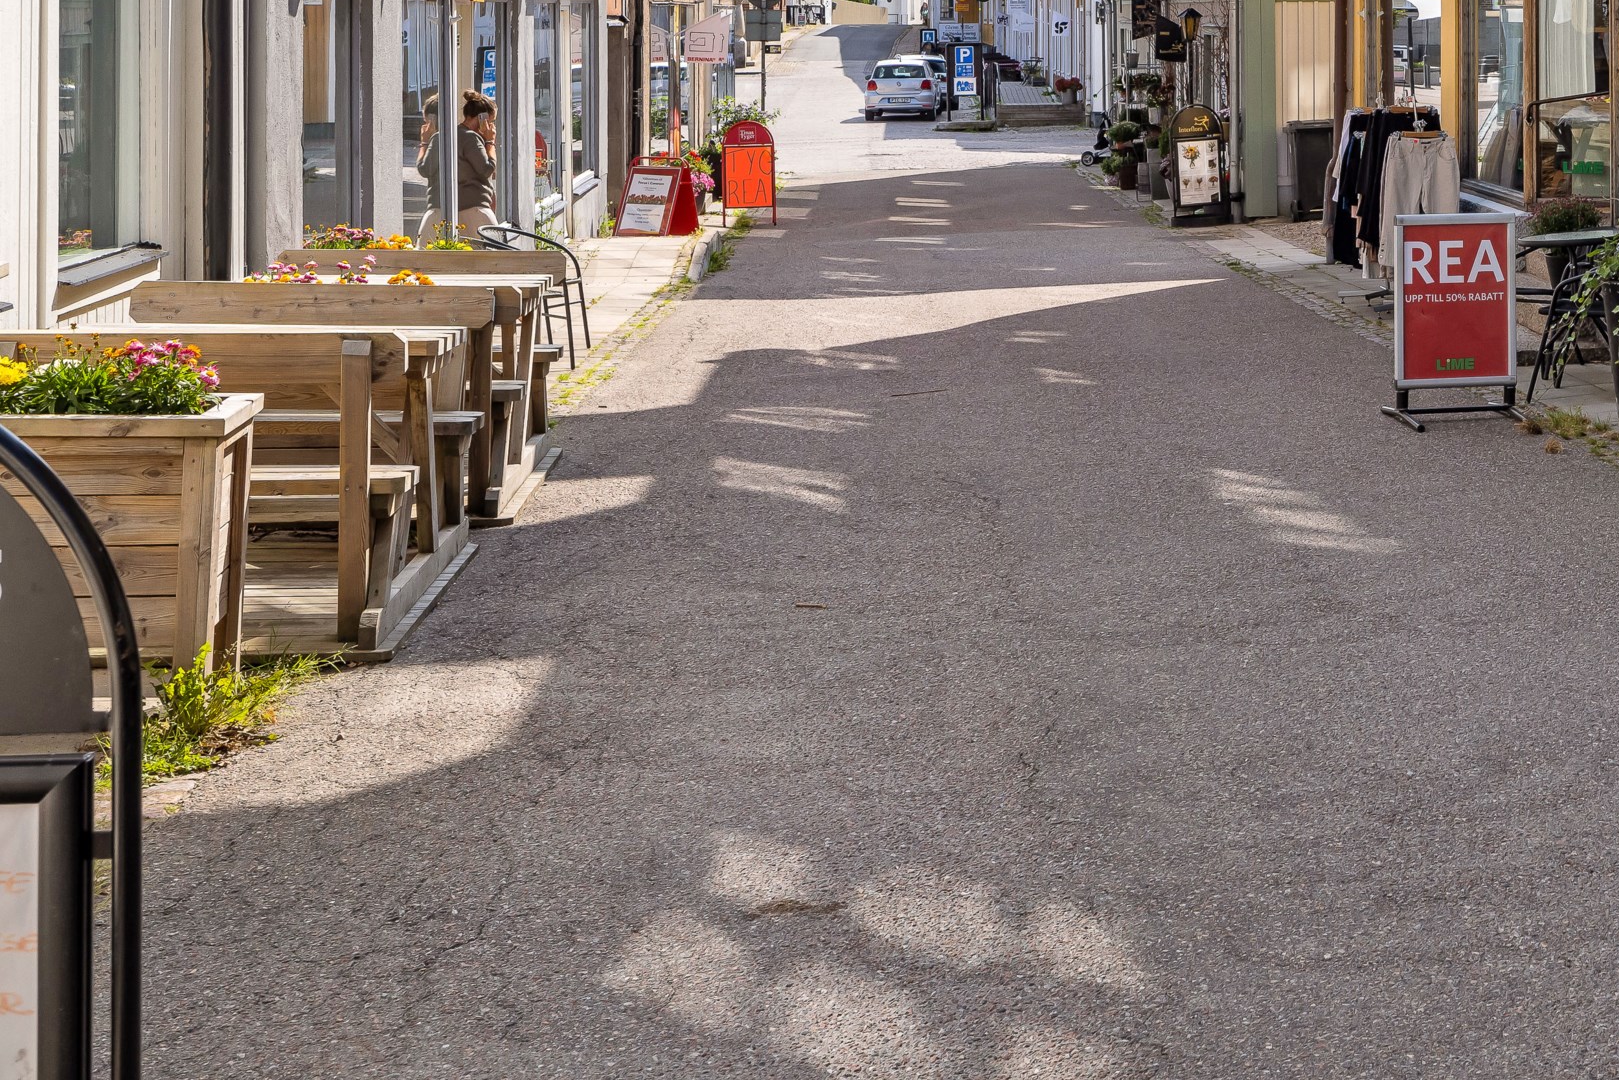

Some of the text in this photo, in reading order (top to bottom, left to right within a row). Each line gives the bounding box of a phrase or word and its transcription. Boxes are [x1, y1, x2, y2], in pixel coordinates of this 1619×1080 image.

[960, 49, 970, 62] P
[728, 178, 767, 204] REA
[1404, 240, 1505, 284] REA
[1405, 292, 1505, 303] UPP TILL 50% RABATT
